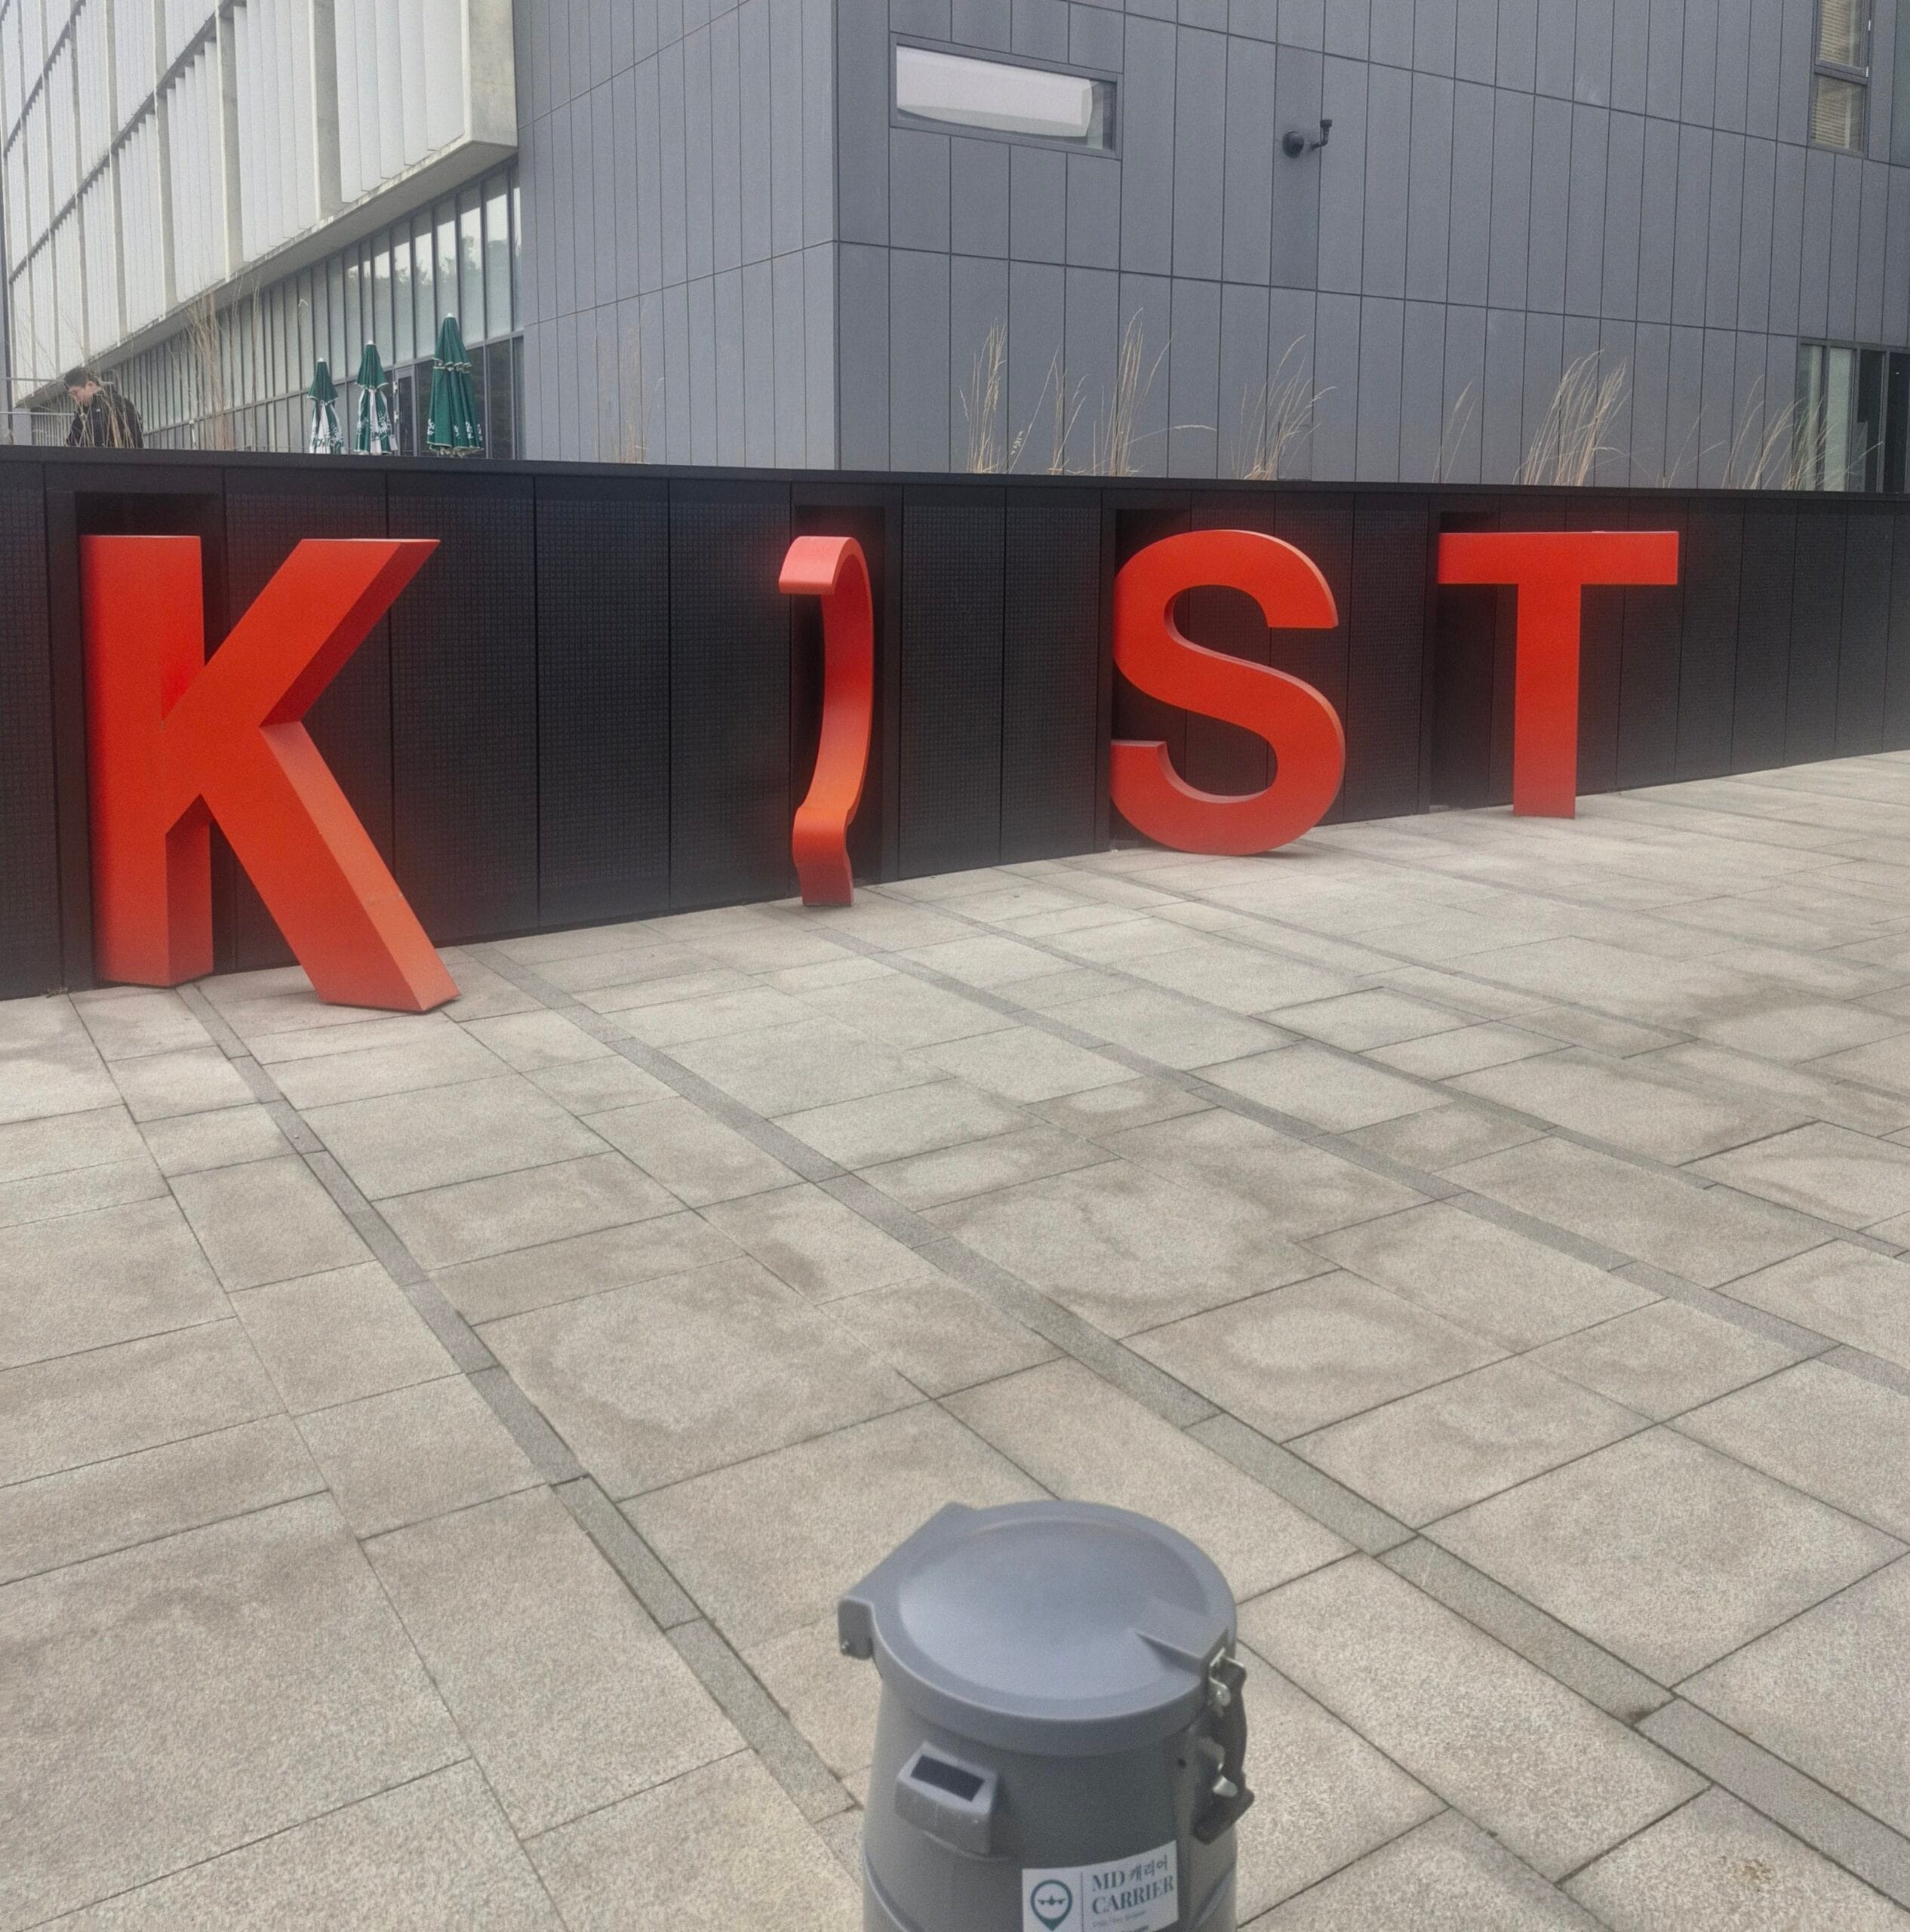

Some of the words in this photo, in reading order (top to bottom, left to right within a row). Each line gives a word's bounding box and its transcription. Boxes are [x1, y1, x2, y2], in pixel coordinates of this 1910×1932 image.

[1092, 1870, 1126, 1892] MD
[1130, 1854, 1168, 1881] 캐리어
[1092, 1875, 1175, 1915] CARRIER
